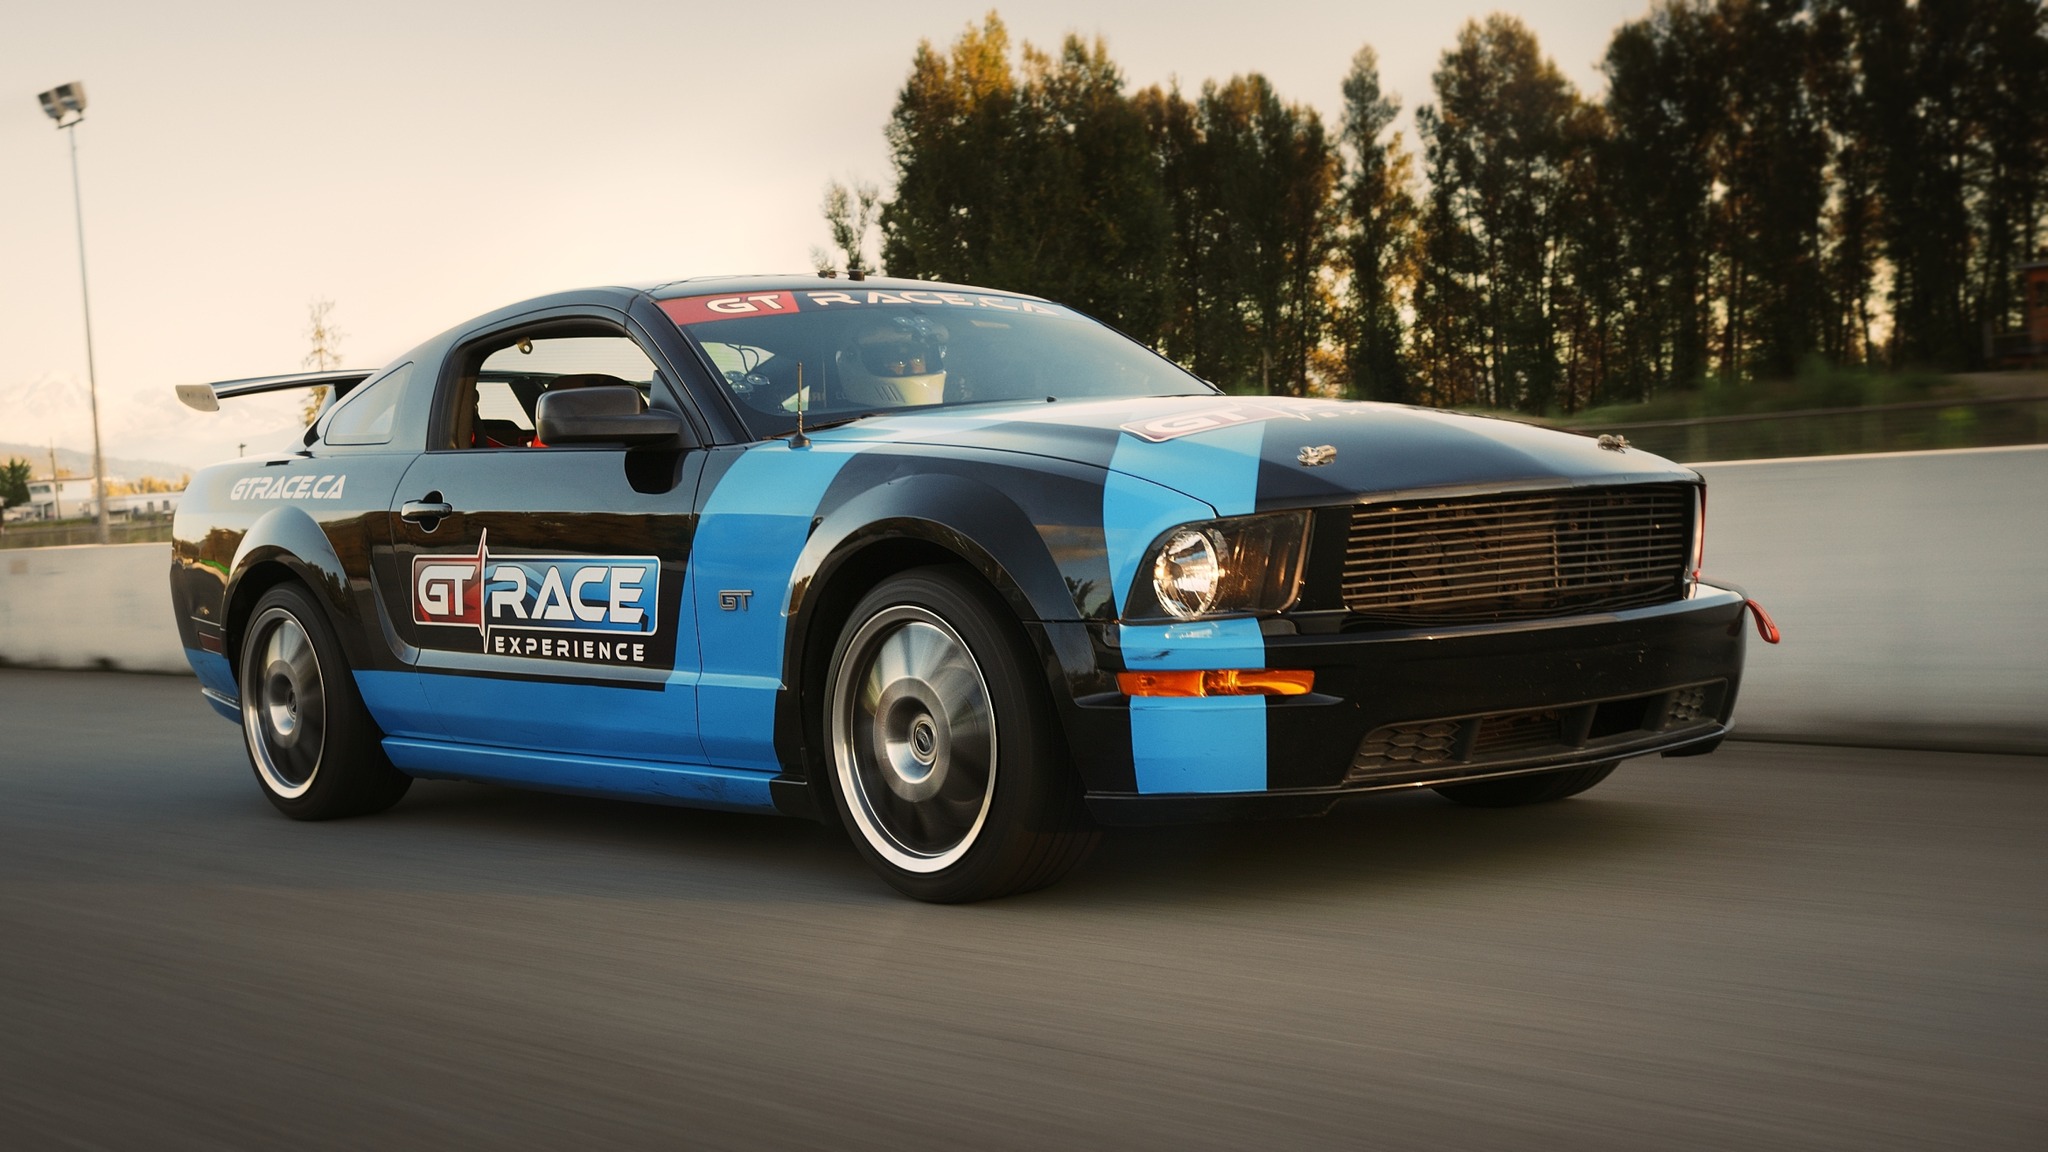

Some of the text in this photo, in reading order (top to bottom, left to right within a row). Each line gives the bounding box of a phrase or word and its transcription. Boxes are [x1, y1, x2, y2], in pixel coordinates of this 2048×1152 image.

[706, 294, 782, 314] GT
[230, 474, 347, 500] GTRACE.CA
[418, 565, 647, 623] GT RACE
[718, 589, 753, 611] GT
[495, 636, 645, 662] EXPERIENCE
